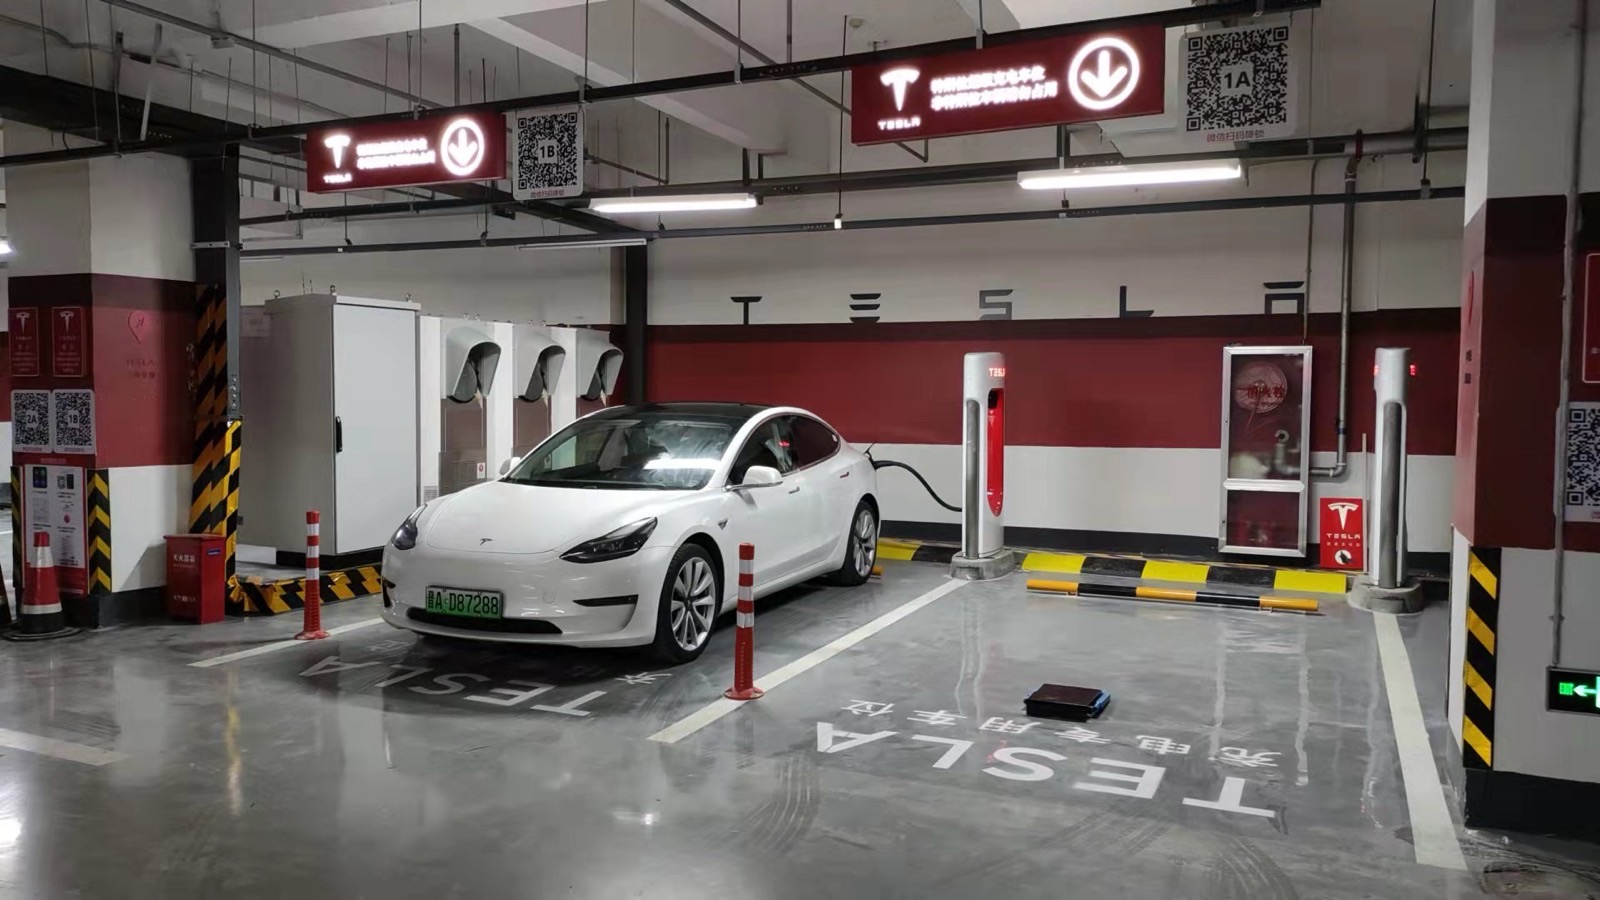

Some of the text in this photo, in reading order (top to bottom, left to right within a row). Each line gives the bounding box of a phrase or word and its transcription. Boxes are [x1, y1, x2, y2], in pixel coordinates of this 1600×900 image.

[1224, 71, 1251, 89] 1A
[540, 145, 555, 159] 1B
[730, 280, 1305, 325] TESLA
[27, 414, 37, 424] 2A
[69, 414, 79, 424] 1B
[299, 655, 608, 717] TESLA
[816, 721, 1276, 818] TESLA
